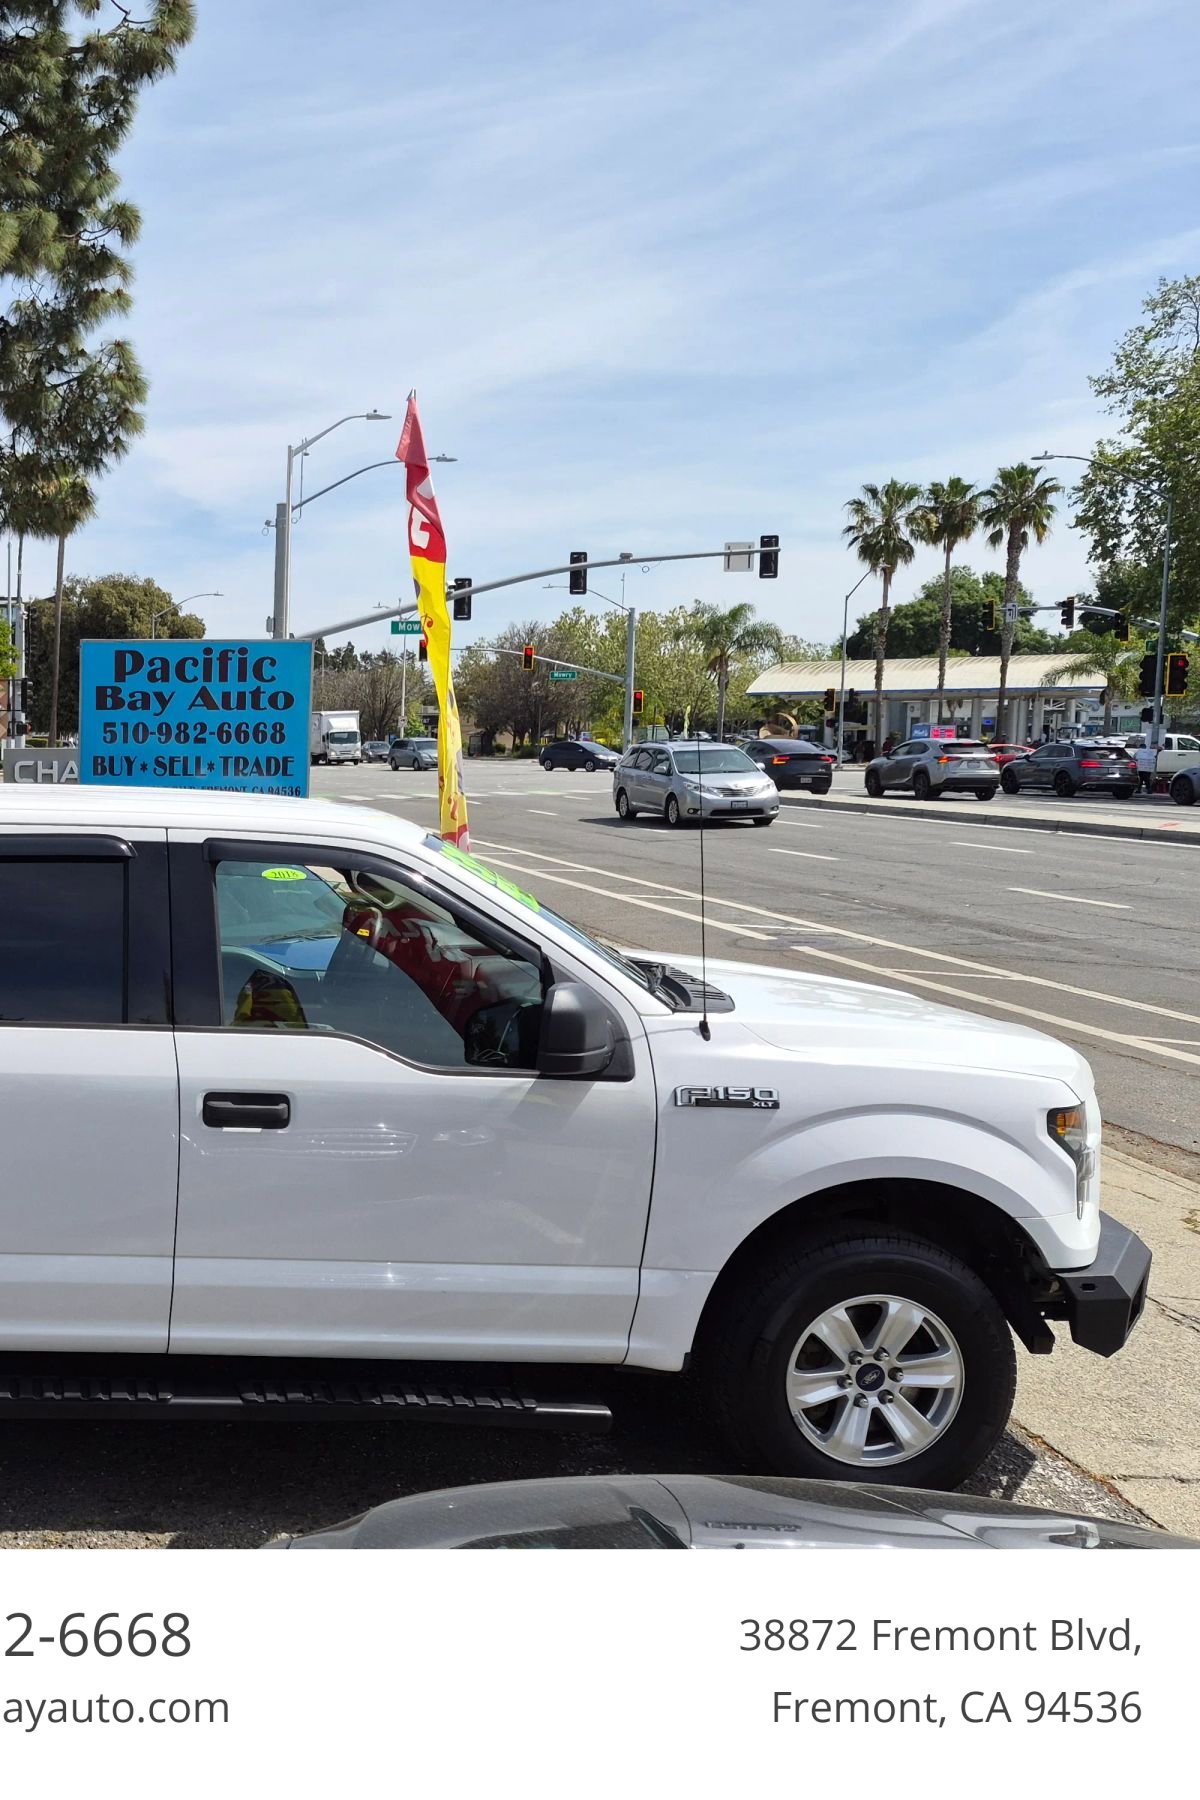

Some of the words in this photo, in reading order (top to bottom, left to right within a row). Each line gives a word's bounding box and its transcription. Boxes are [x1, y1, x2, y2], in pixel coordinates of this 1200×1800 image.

[114, 647, 277, 683] Pacific
[95, 686, 175, 717] Bay
[187, 686, 295, 711] Auto
[103, 721, 286, 745] 510-982-6668
[93, 756, 138, 777] BUY
[153, 755, 207, 777] SELL
[219, 756, 294, 777] TRADE
[252, 785, 265, 794] CA
[268, 785, 301, 798] 94536
